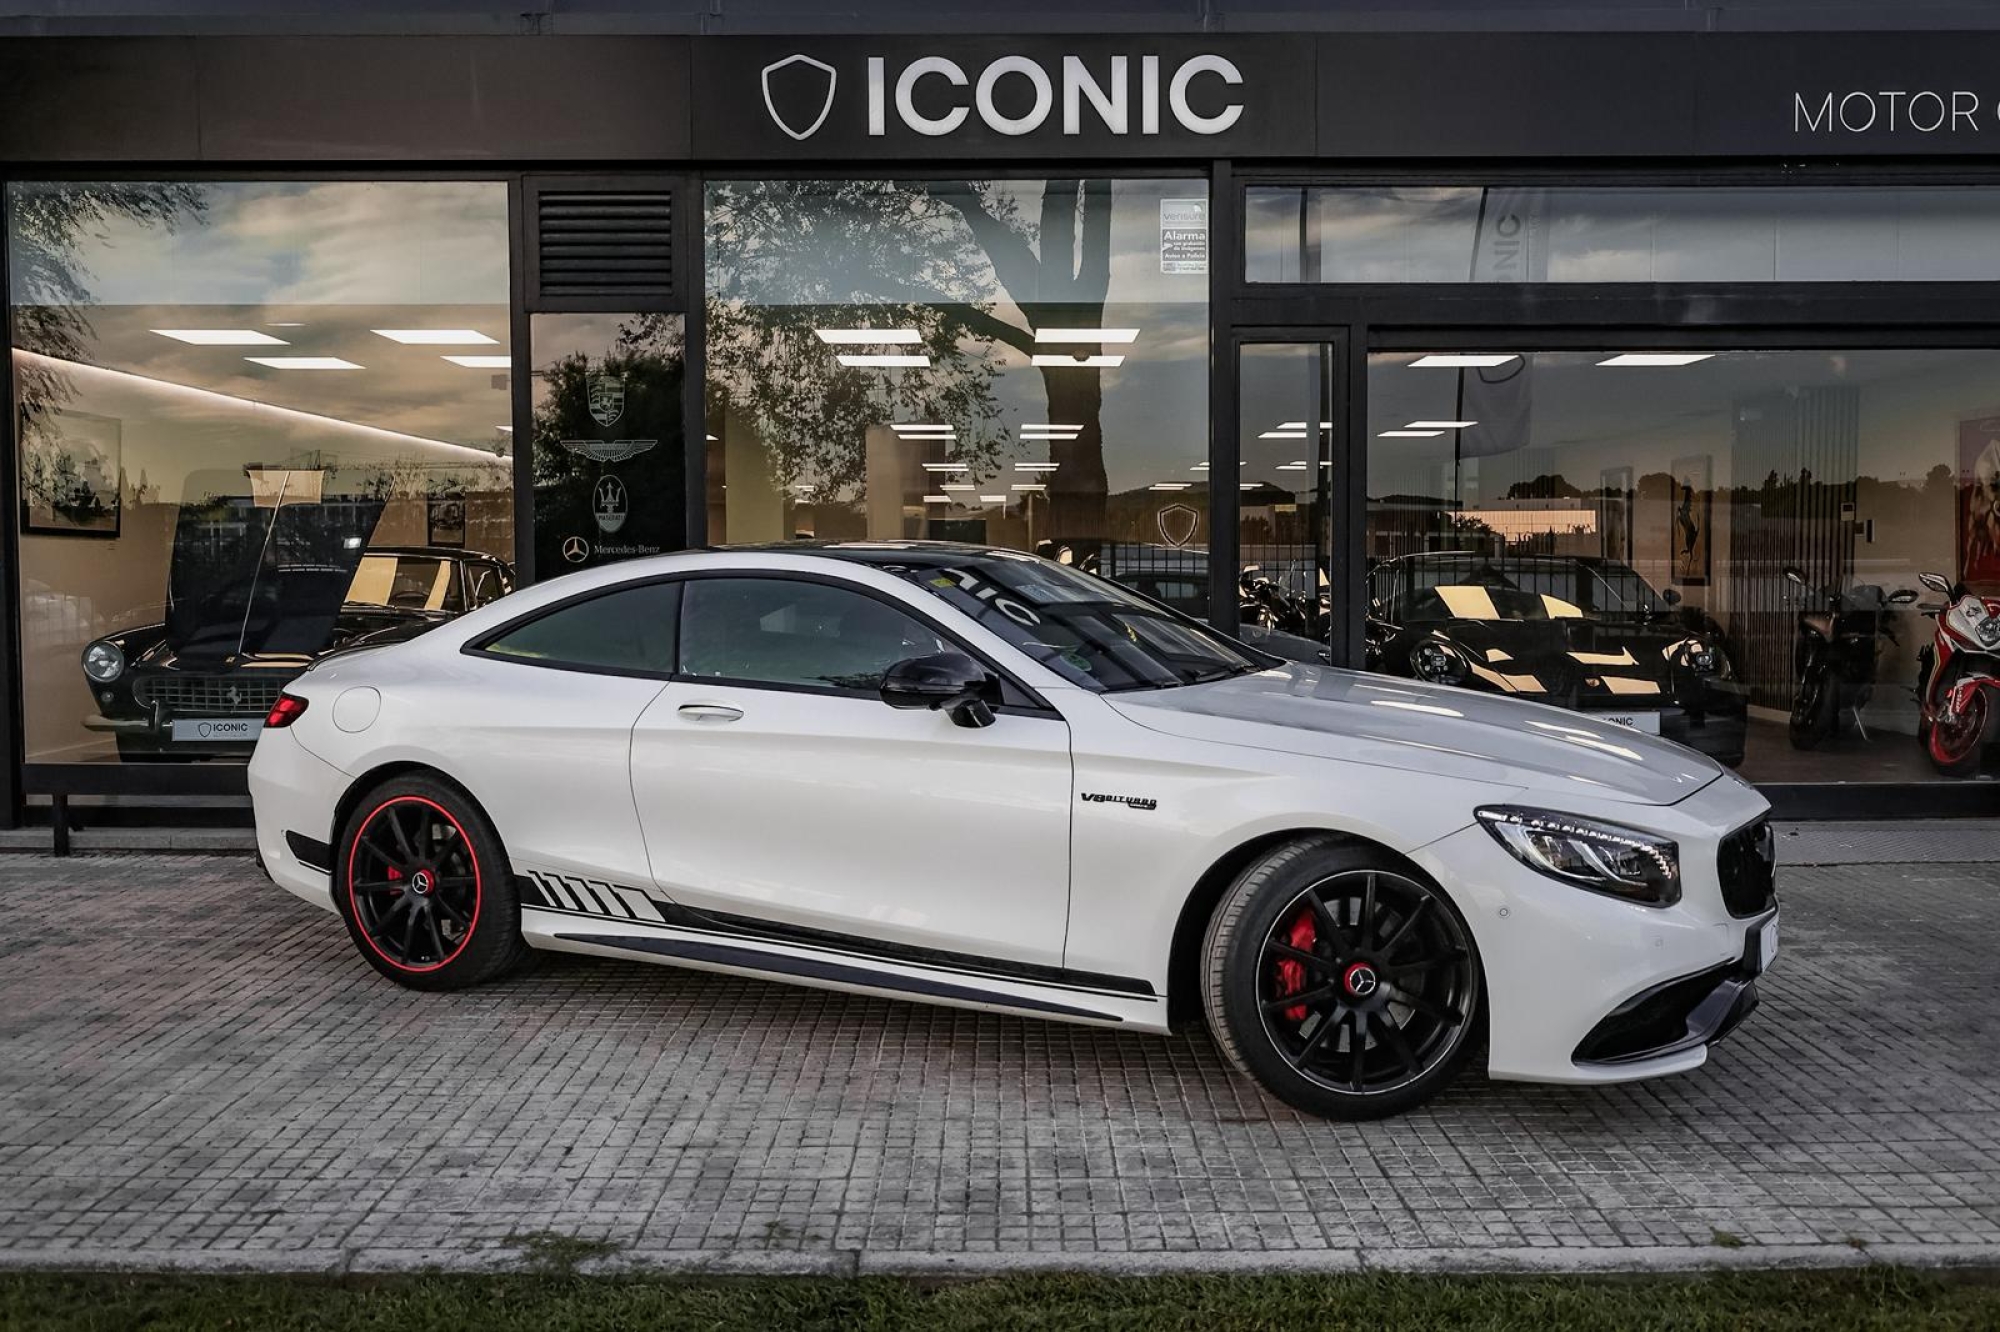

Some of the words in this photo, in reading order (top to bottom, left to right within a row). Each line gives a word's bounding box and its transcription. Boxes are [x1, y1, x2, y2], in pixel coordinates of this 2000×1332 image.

[868, 54, 1244, 136] ICONIC
[1794, 91, 1980, 132] MOTOR
[1164, 230, 1206, 240] Alarma
[594, 544, 660, 554] Mercedes-Benz
[213, 722, 248, 732] ICONIC
